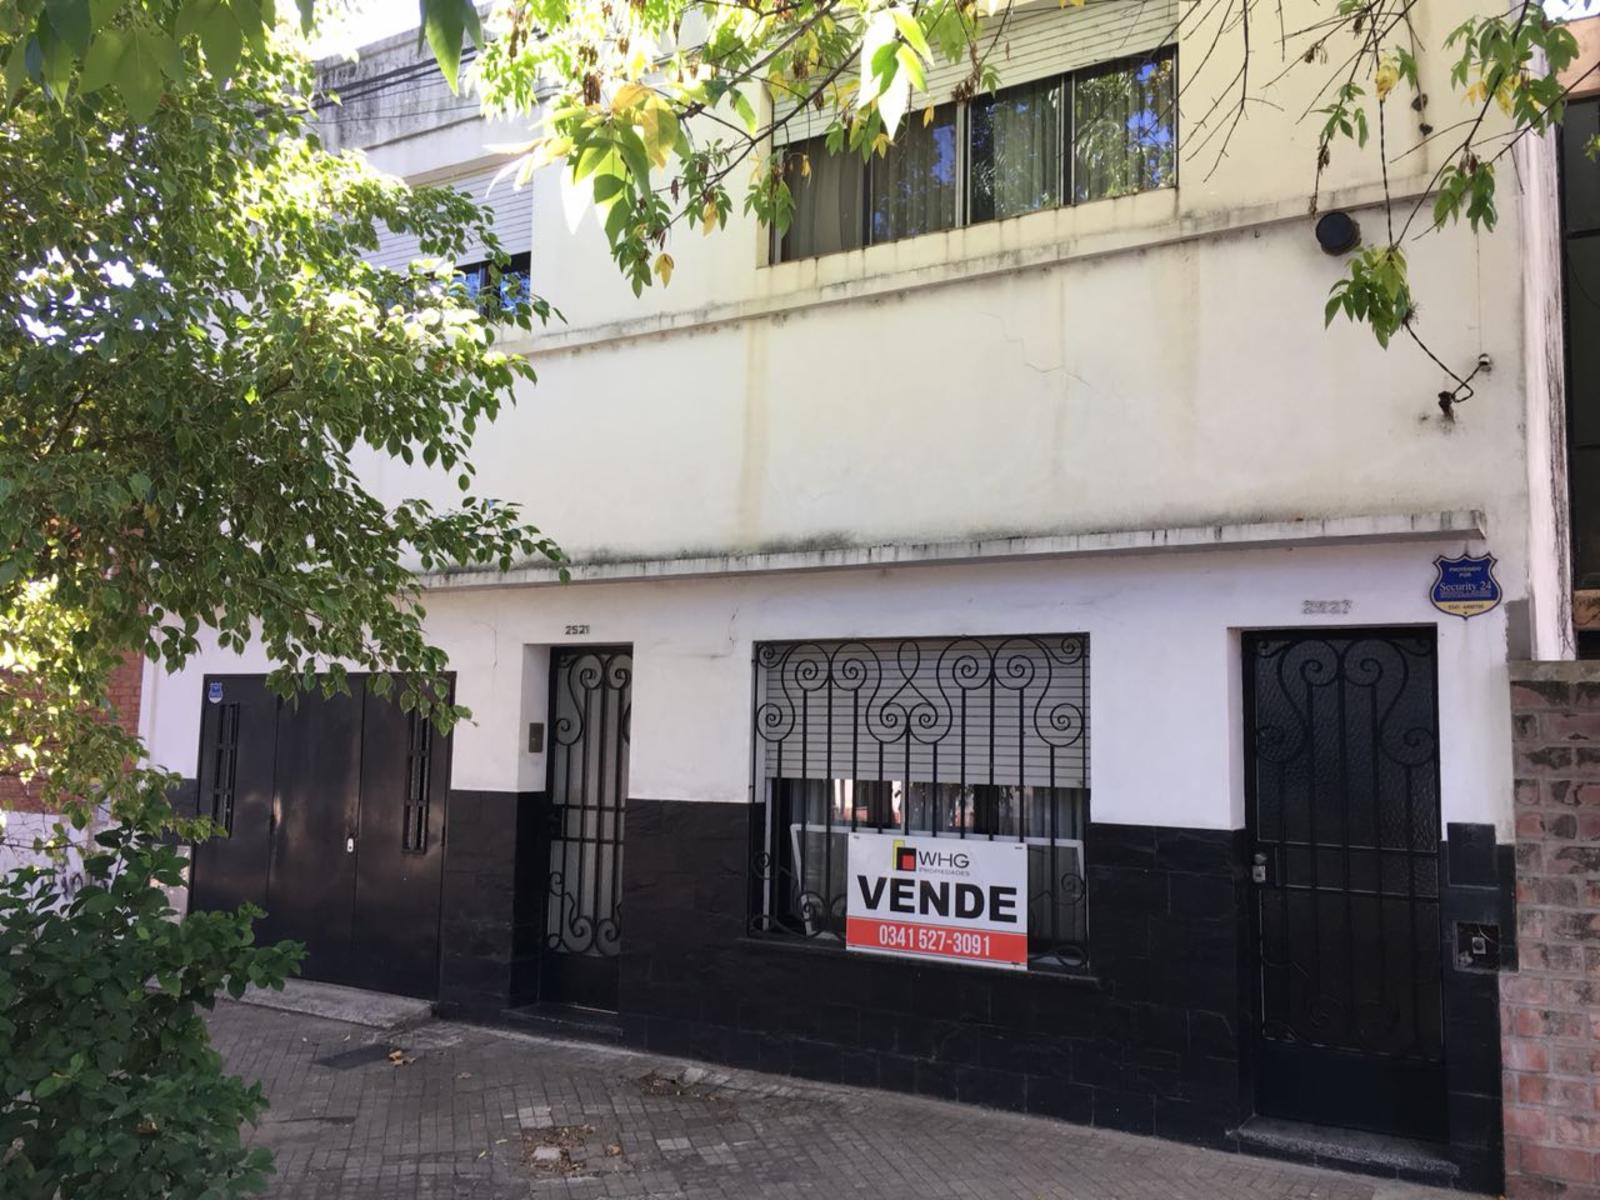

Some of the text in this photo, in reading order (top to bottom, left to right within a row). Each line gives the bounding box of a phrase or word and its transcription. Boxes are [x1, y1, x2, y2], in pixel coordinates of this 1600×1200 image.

[1439, 581, 1492, 593] Security 24
[918, 852, 970, 868] WHG
[857, 875, 1018, 924] VENDE
[879, 925, 990, 956] 0341 527-3091
